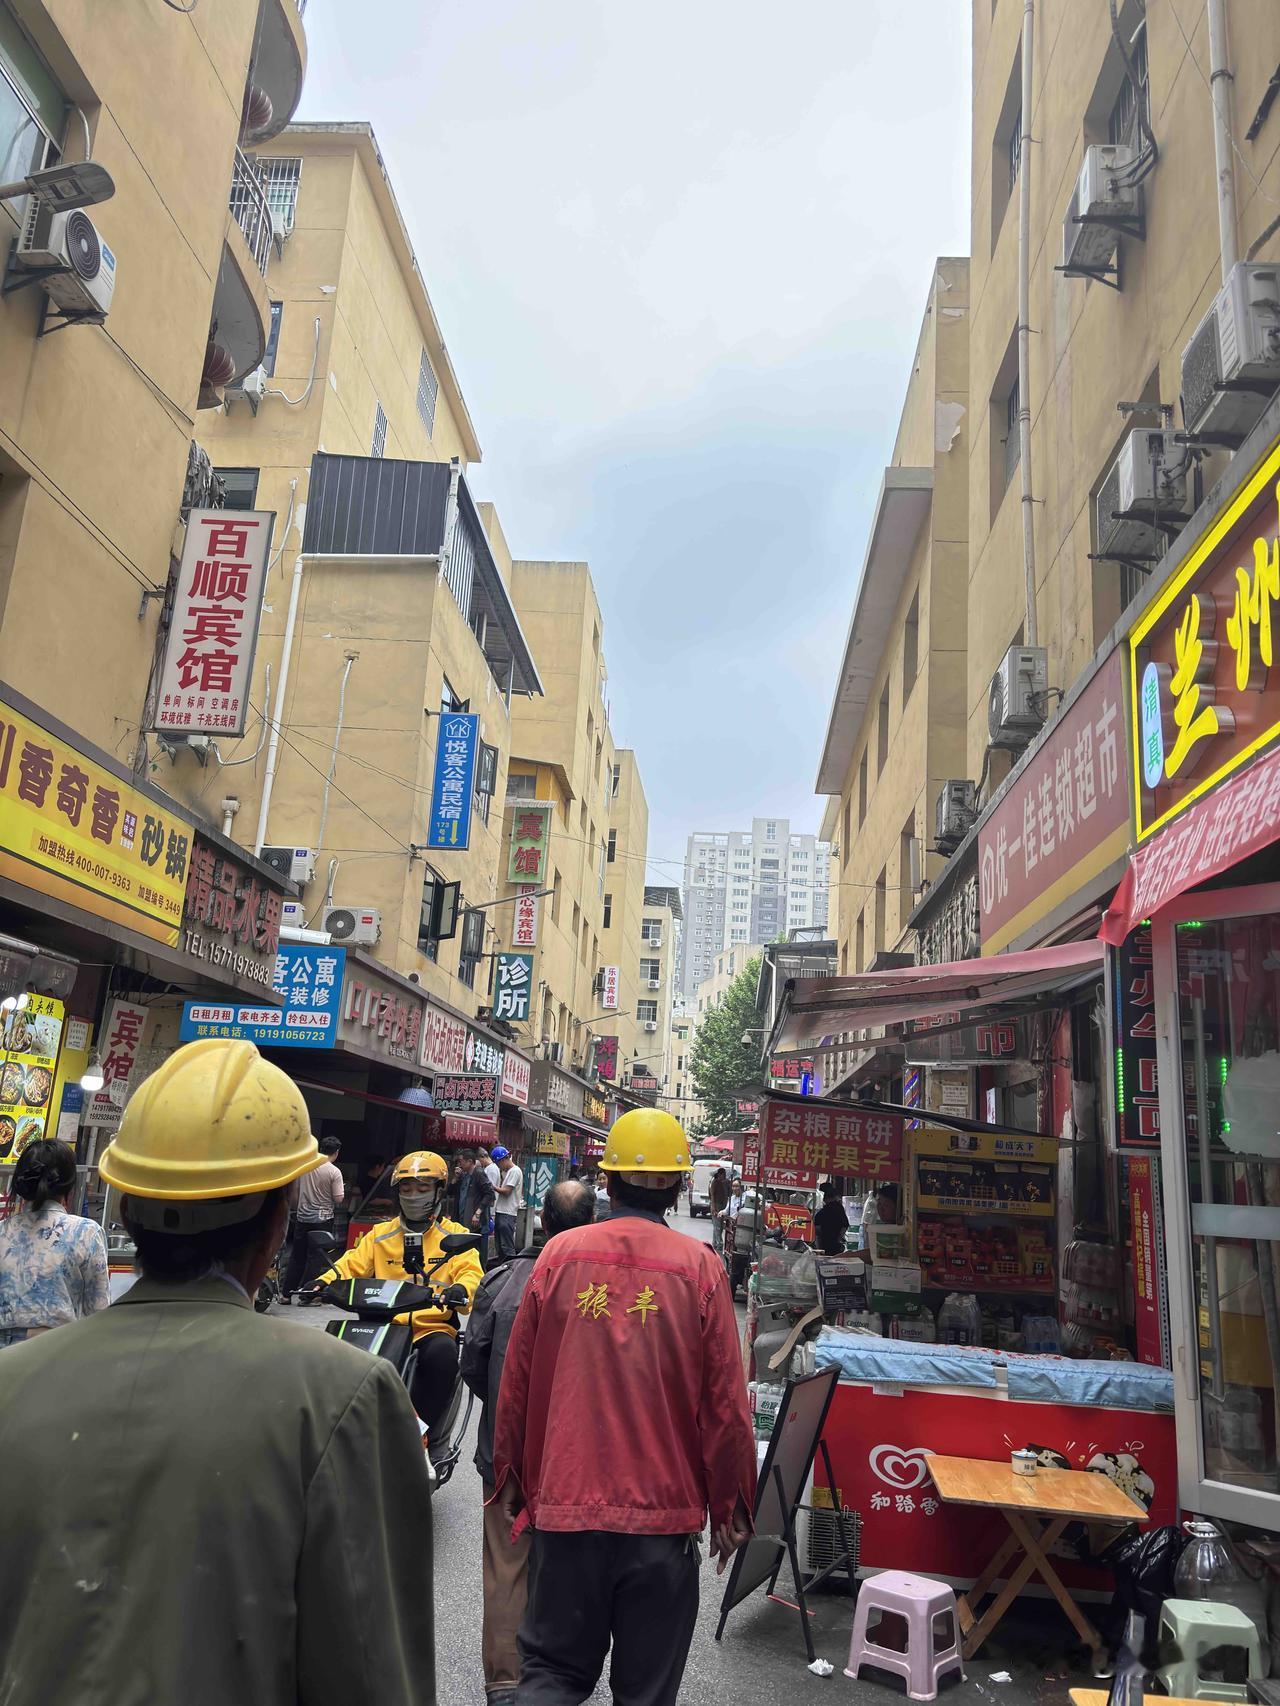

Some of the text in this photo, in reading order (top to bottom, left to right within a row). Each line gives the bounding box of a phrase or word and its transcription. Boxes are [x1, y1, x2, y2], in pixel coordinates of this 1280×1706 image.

[176, 518, 260, 693] 百顺宾馆
[160, 711, 236, 728] 环境优雅 千兆无线网
[211, 698, 239, 712] 空调房
[1145, 679, 1162, 773] 清真
[438, 740, 469, 819] 悦客公寓民宿
[996, 700, 1118, 904] 优一佳连锁超市
[38, 835, 131, 892] 加盟热线 400-007-9363
[141, 815, 188, 885] 砂锅
[514, 811, 543, 874] 宾馆
[1131, 811, 1209, 917] 新店开业
[165, 898, 181, 916] 3449
[517, 886, 535, 940] 同心缘宾馆
[496, 955, 531, 1019] 诊所
[606, 967, 616, 1004] 乐居宾馆
[192, 1008, 328, 1025] 日租月租 家电齐全 拎包入住
[254, 1029, 326, 1041] 19191056723
[102, 1009, 144, 1089] 宾馆
[444, 1077, 496, 1100] 卤肉凉菜
[773, 1109, 894, 1146] 杂粮煎饼
[770, 1137, 892, 1174] 煎饼果子
[528, 1161, 554, 1200] 诊
[576, 1281, 659, 1328] 振丰
[870, 1490, 939, 1516] 和路雪
